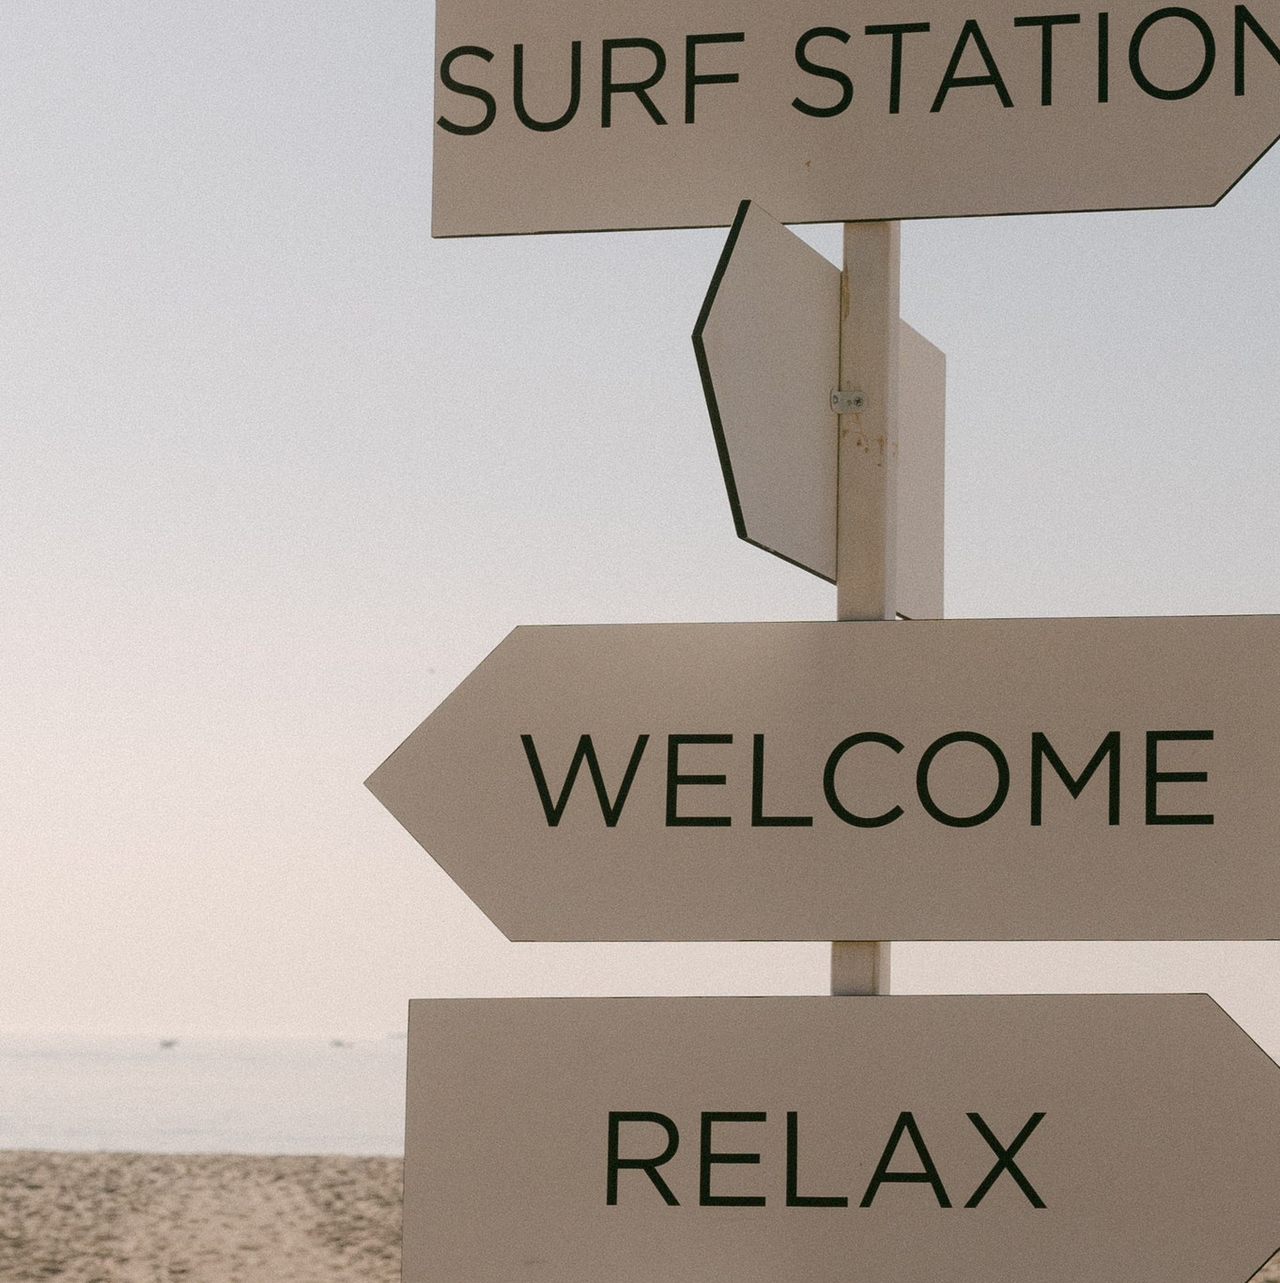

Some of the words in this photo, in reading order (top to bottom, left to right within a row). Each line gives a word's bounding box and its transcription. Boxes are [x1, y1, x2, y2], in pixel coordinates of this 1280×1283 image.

[435, 30, 747, 137] SURF
[518, 728, 1217, 830] WELCOME
[604, 1109, 1049, 1211] RELAX
